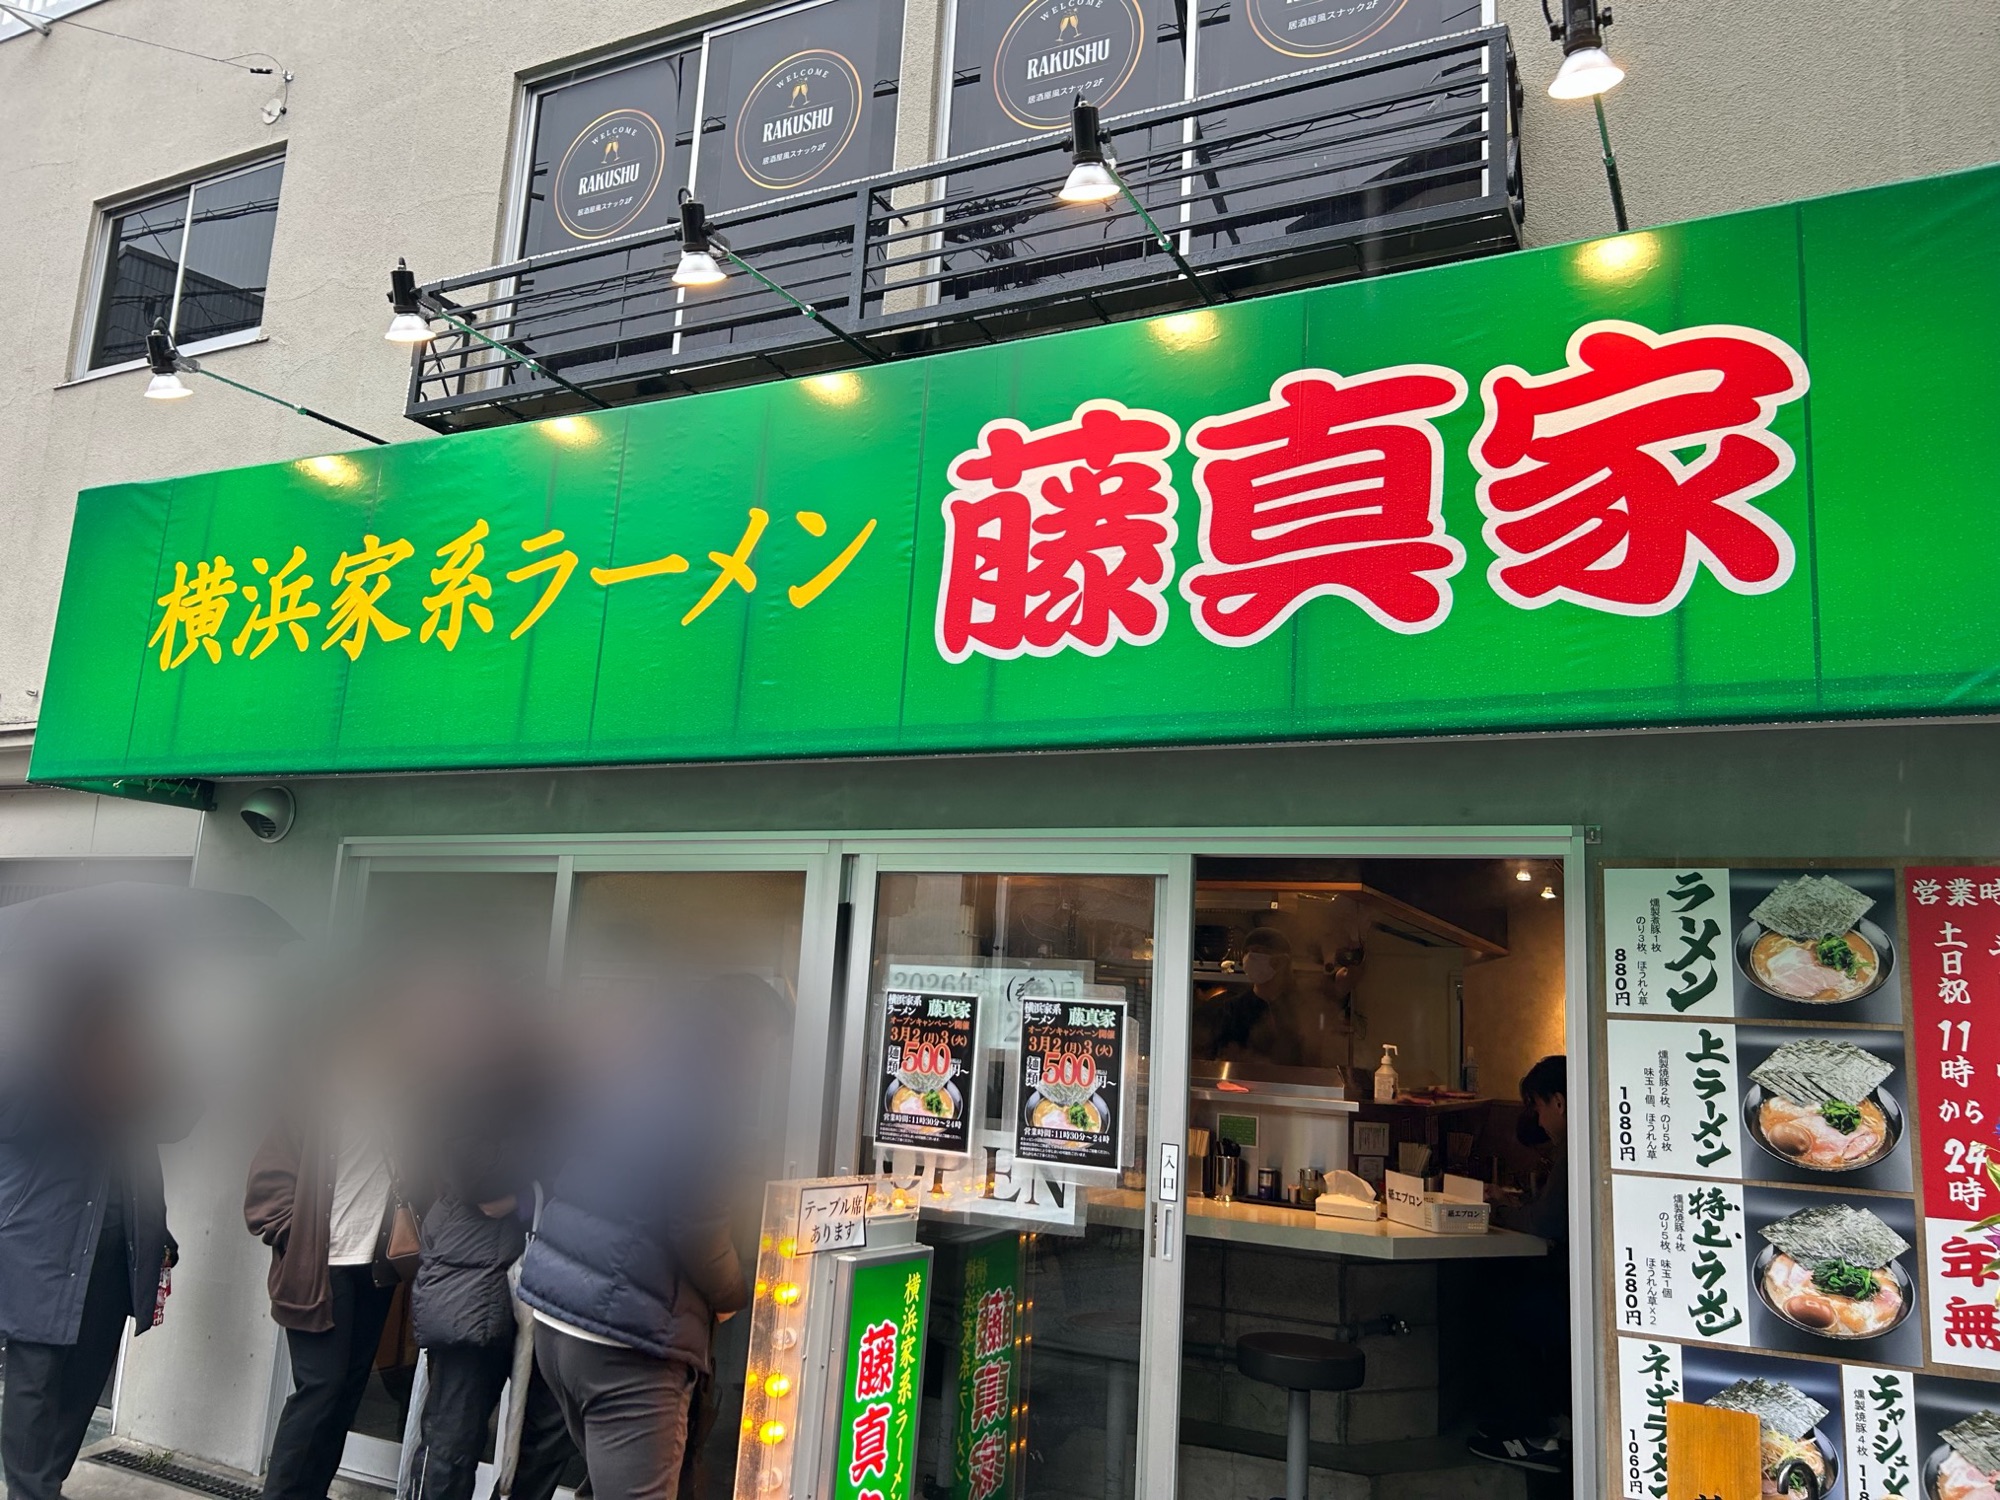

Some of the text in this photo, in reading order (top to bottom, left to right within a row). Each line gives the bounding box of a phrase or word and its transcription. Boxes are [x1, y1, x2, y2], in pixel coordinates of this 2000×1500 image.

[1040, 0, 1104, 22] WELCOME
[1026, 38, 1110, 80] RAKUSHU
[776, 67, 830, 89] WELCOME
[591, 126, 638, 145] WELCOME
[762, 106, 834, 143] RAKUSHU
[577, 162, 640, 195] RAKUSHU
[148, 320, 1811, 671] 横浜家系ラーメン 藤真家
[1664, 872, 1721, 1013] ラーメン
[1614, 948, 1631, 1006] 880円
[1934, 920, 1972, 1005] 土日祝
[887, 1006, 916, 1016] ラーメン
[888, 994, 922, 1006] 横浜家系
[927, 999, 972, 1019] 藤真家
[1024, 1002, 1062, 1015] 横浜家系
[1024, 1014, 1056, 1025] ラーメン
[1068, 1007, 1117, 1028] 藤真家
[901, 1041, 951, 1075] 500
[1041, 1051, 1097, 1087] 500
[1685, 1028, 1732, 1168] 上ラーメン
[1618, 1086, 1636, 1162] 1080円
[1163, 1155, 1175, 1190] 入口
[805, 1195, 863, 1221] テーブル席
[1388, 1188, 1423, 1207] 紙エプロン
[1447, 1209, 1480, 1218] 紙エプロン
[810, 1220, 855, 1244] あります
[1687, 1186, 1742, 1337] 特上ラーメン
[1624, 1246, 1642, 1326] 1280円
[849, 1319, 898, 1500] 藤真
[1628, 1428, 1643, 1494] 1060円
